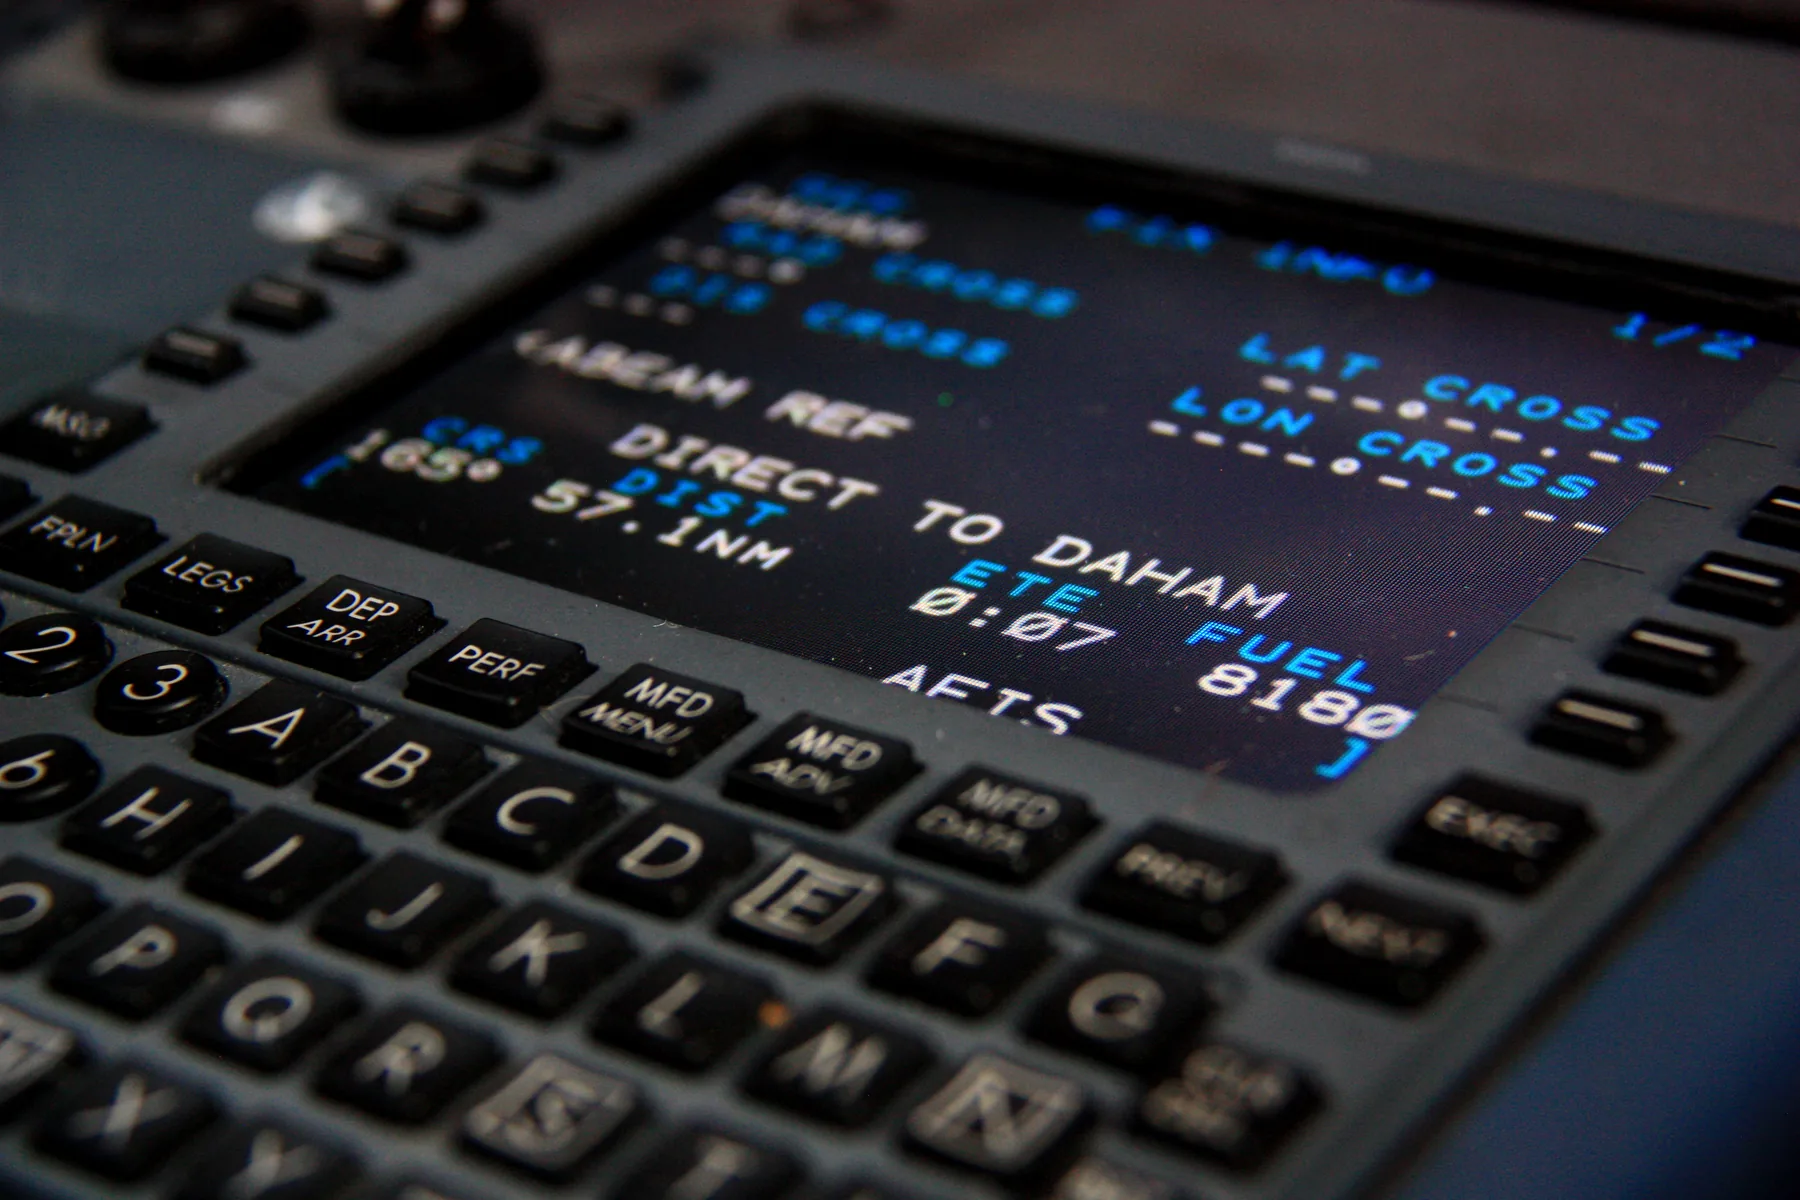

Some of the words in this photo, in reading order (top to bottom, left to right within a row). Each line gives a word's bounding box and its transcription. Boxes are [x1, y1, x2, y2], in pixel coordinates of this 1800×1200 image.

[1239, 332, 1381, 381] LAT
[1422, 373, 1661, 443] CROSS
[422, 415, 541, 465] CRS
[766, 390, 913, 441] REF
[1170, 385, 1315, 437] LON
[1357, 430, 1599, 500] CROSS
[610, 423, 880, 510] DIRECT
[913, 499, 1003, 545] TO
[1032, 535, 1290, 620] DAHAM
[613, 467, 788, 527] DIST
[30, 515, 117, 553] FPLN
[162, 555, 253, 594] LEGS
[951, 558, 1099, 615] ETE
[325, 588, 399, 623] DEP
[5, 626, 77, 663] 2
[287, 618, 366, 647] ARR
[1185, 620, 1376, 694] FUEL
[123, 664, 188, 700] 3
[447, 643, 545, 682] PERF
[625, 676, 715, 718] MFD
[1198, 663, 1415, 740] 8180
[228, 708, 305, 749] A
[579, 702, 691, 746] MENU
[786, 725, 882, 771] MFD
[361, 741, 430, 788] B
[102, 787, 192, 840] H
[496, 785, 577, 835] C
[618, 823, 703, 879] D
[366, 882, 443, 931] J
[90, 924, 178, 978] P
[487, 918, 588, 987] K
[912, 917, 1006, 975] F
[352, 1020, 447, 1096] R
